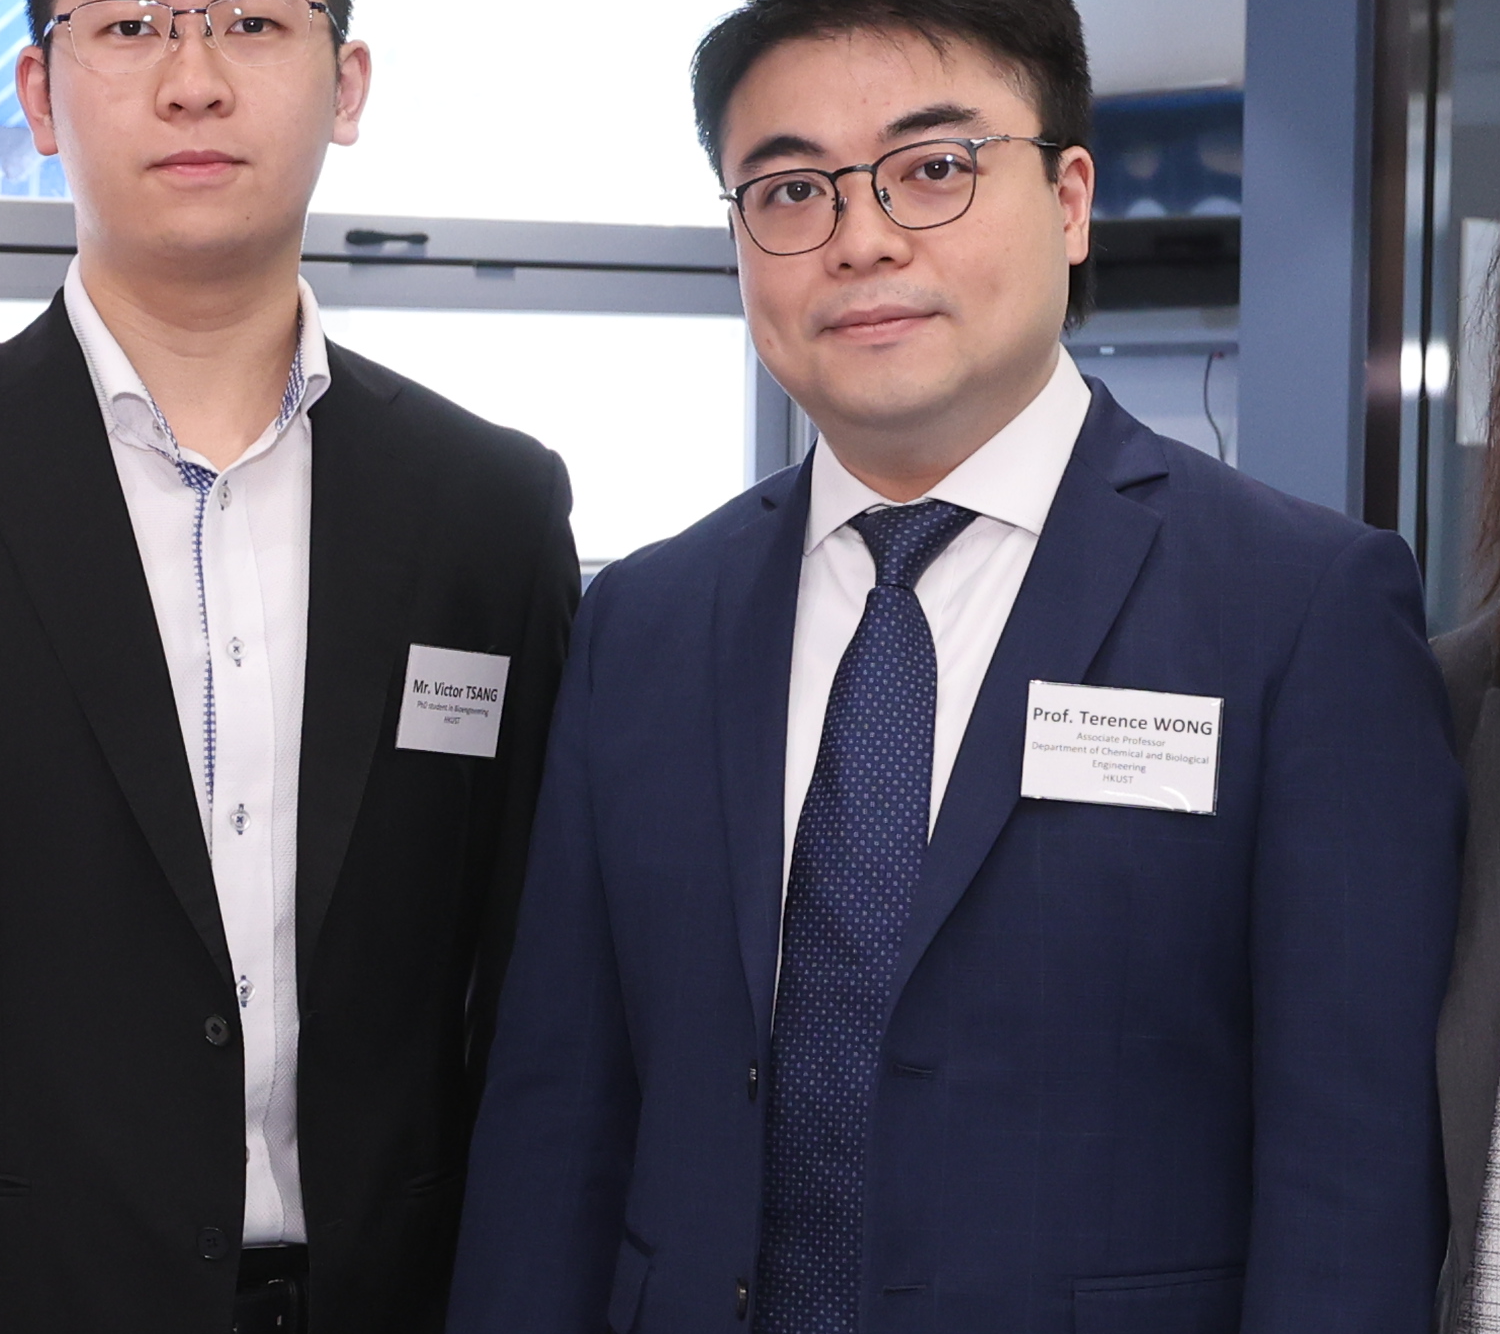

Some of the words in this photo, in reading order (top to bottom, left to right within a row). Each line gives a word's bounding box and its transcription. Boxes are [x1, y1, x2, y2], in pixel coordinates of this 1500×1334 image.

[413, 679, 430, 695] Mr.
[434, 682, 463, 699] Victor
[466, 686, 498, 702] TSANG
[1033, 707, 1073, 724] Prof.
[1080, 711, 1147, 730] Terence
[1154, 717, 1213, 736] WONG
[1077, 732, 1120, 744] Associate
[1123, 735, 1166, 747] Professor
[1032, 742, 1087, 755] Department
[1090, 746, 1100, 755] of
[1101, 747, 1143, 759] Chemical
[1146, 752, 1162, 761] and
[1166, 753, 1209, 766] Biological
[1092, 760, 1146, 773] Engineering
[1103, 774, 1134, 784] HKUST
